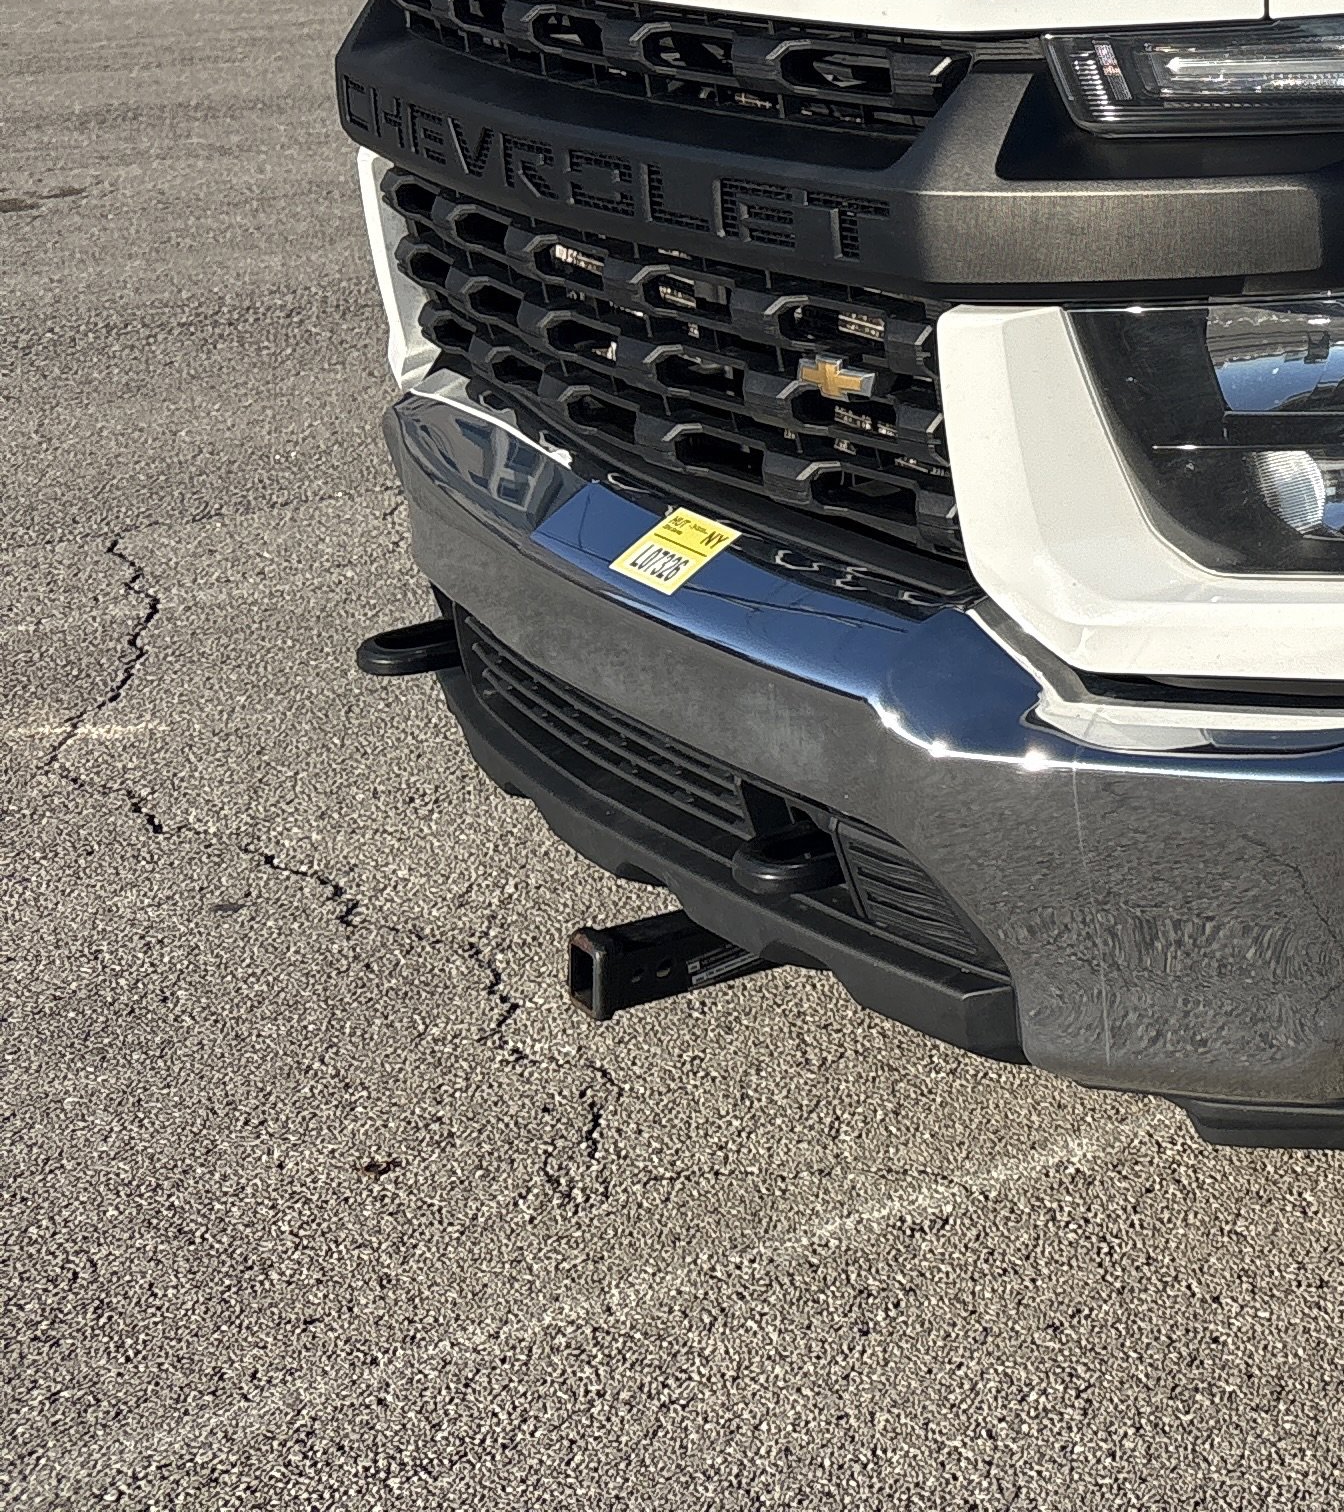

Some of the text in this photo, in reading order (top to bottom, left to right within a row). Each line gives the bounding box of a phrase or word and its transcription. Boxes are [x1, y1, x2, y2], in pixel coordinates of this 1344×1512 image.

[343, 73, 891, 262] CHEVROLET
[699, 531, 729, 549] NY
[629, 544, 689, 582] L07326
